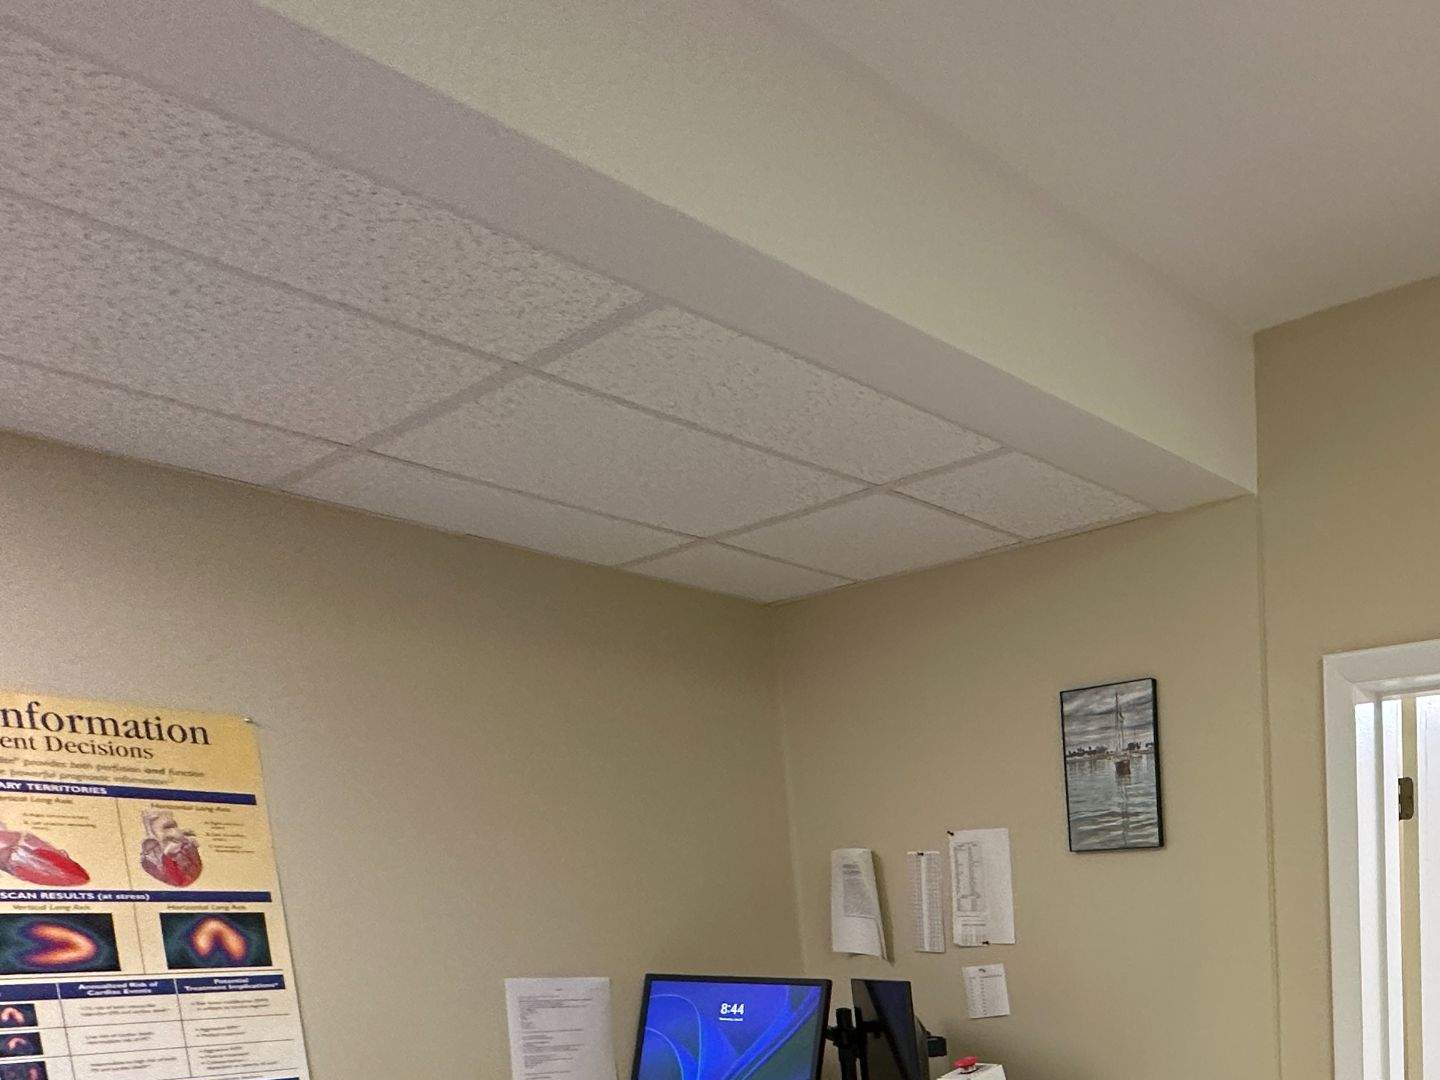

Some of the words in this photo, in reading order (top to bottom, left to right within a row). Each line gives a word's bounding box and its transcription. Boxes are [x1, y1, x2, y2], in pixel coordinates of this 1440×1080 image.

[44, 735, 154, 760] Decisions
[27, 783, 108, 795] TERRITORIES
[0, 892, 37, 900] SCAN
[40, 892, 94, 900] RESULTS
[720, 1002, 745, 1015] 8:44
